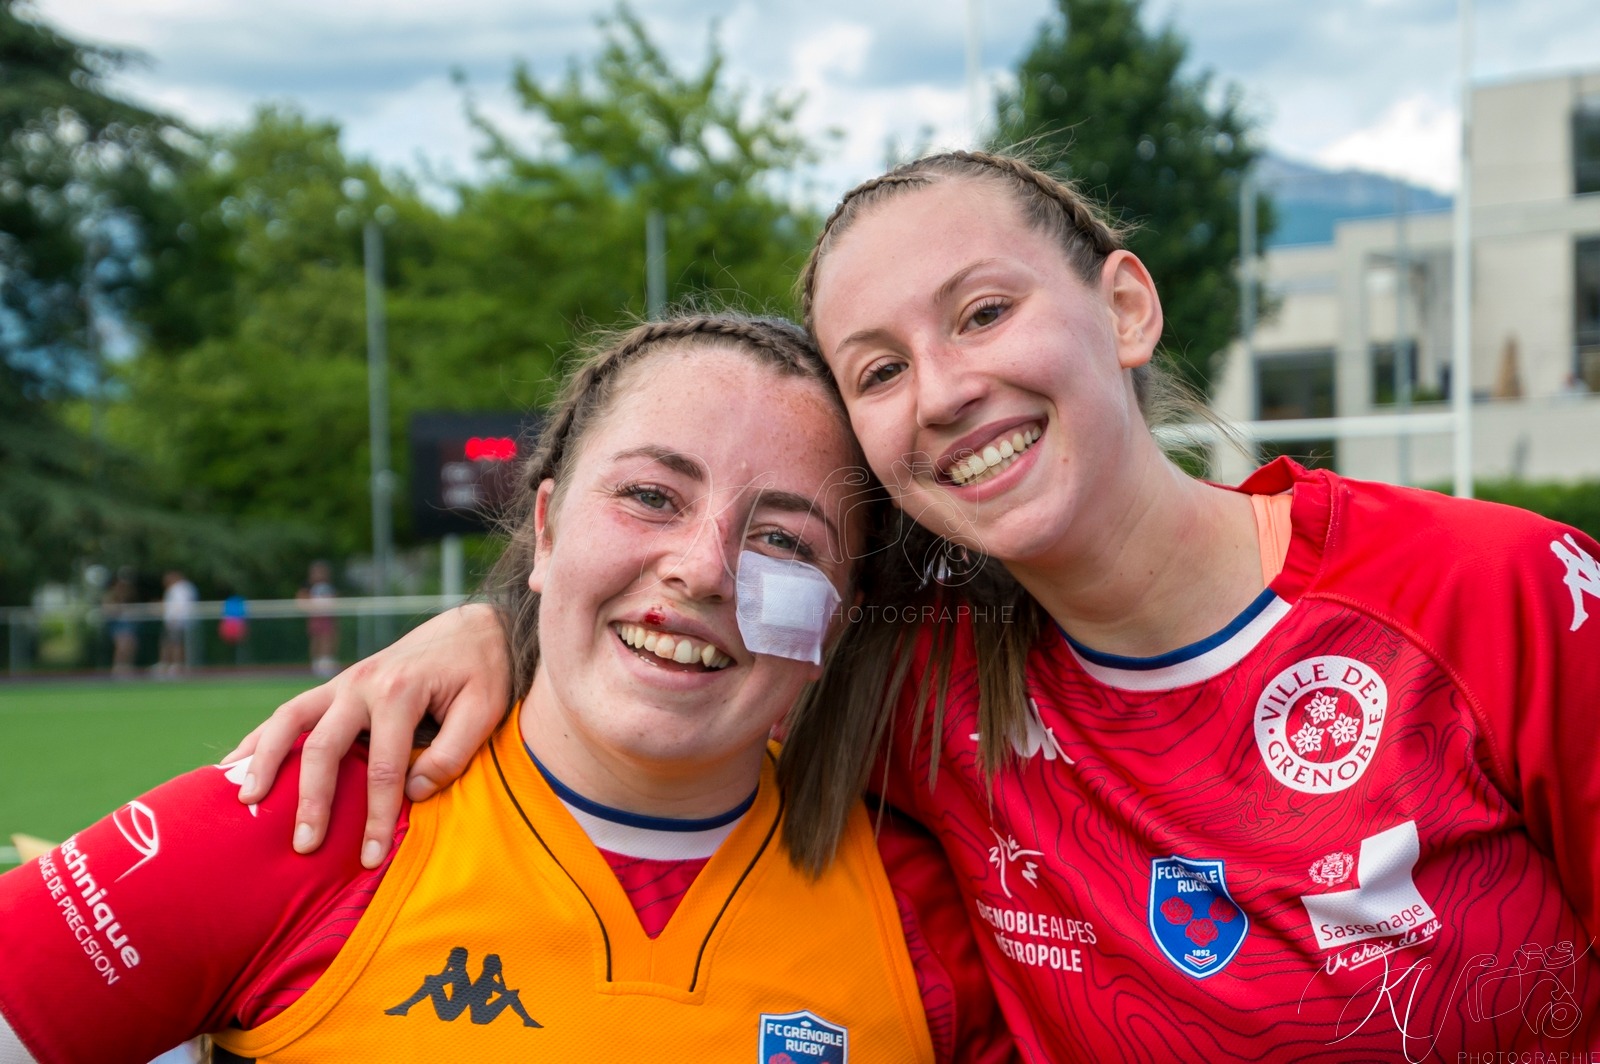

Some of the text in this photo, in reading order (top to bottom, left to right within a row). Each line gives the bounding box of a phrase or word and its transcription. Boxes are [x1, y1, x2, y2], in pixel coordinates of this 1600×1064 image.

[1261, 663, 1377, 722] VILLE DE
[1268, 709, 1383, 787] GRENOBLE
[1177, 880, 1212, 893] RUG
[46, 875, 67, 900] DE
[57, 895, 120, 985] PRECISION
[1320, 904, 1425, 941] Sassenage
[1192, 949, 1210, 957] 1892
[783, 1025, 843, 1047] GRENOBLE
[785, 1038, 825, 1056] RUGBY
